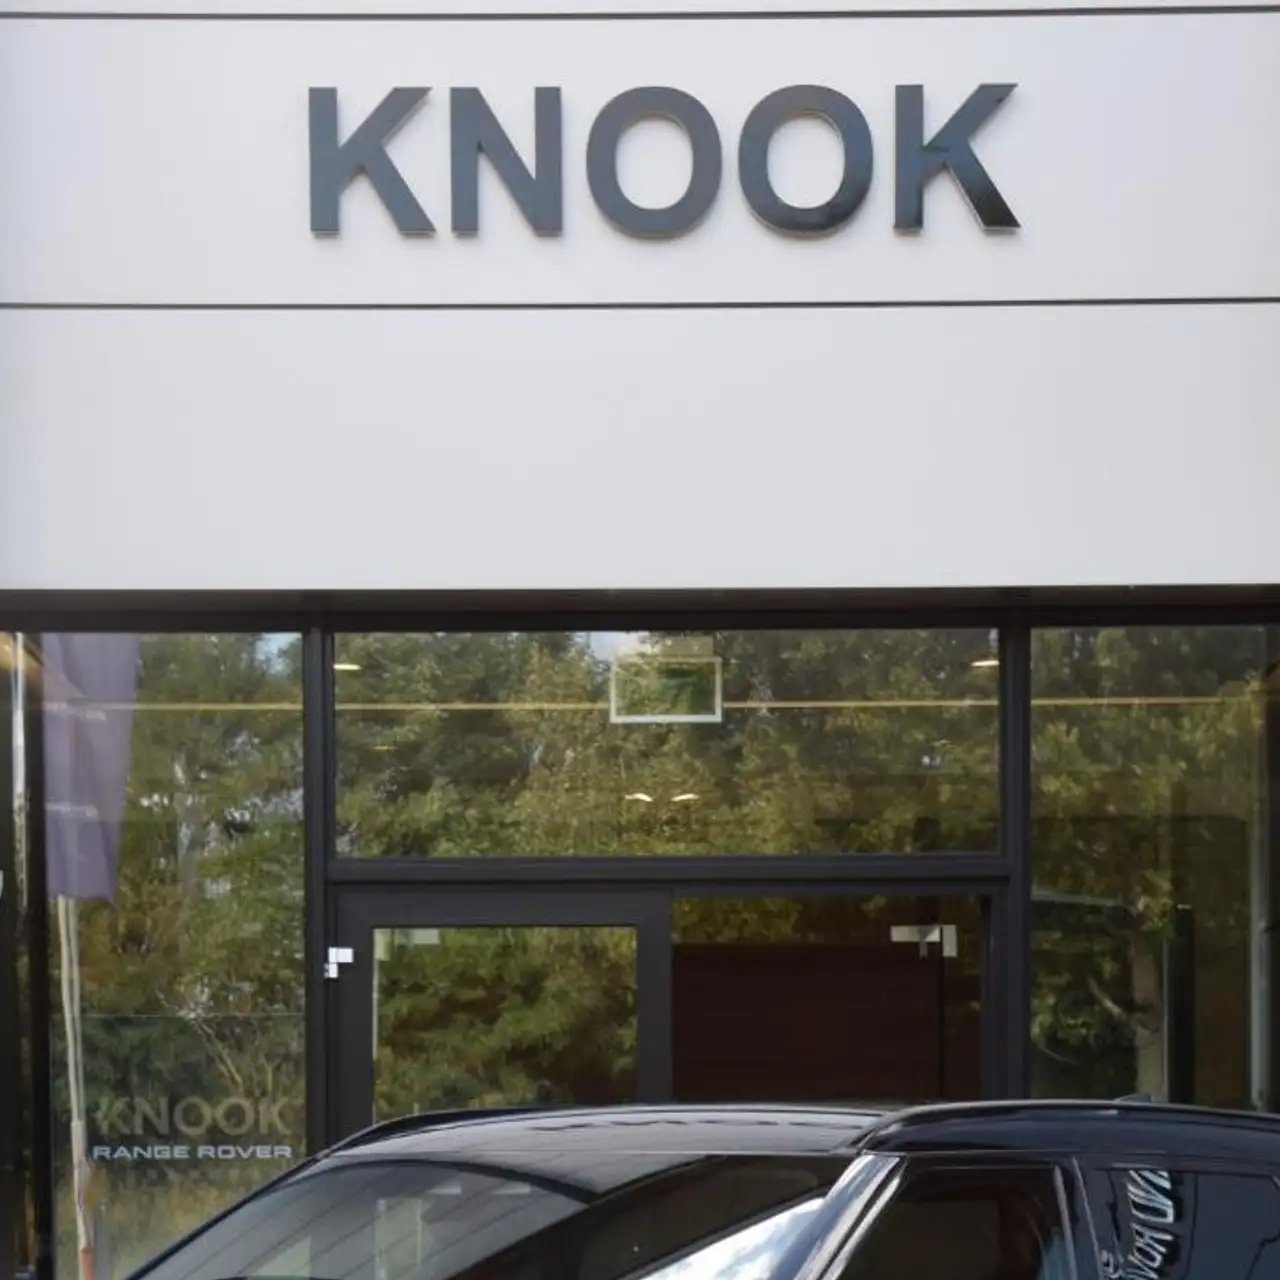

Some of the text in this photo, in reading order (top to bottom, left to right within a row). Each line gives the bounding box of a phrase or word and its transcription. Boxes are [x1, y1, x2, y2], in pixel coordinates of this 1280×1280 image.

[307, 82, 1021, 239] KNOOK
[93, 1096, 293, 1135] KNOOK
[92, 1144, 293, 1160] RANGE ROVER
